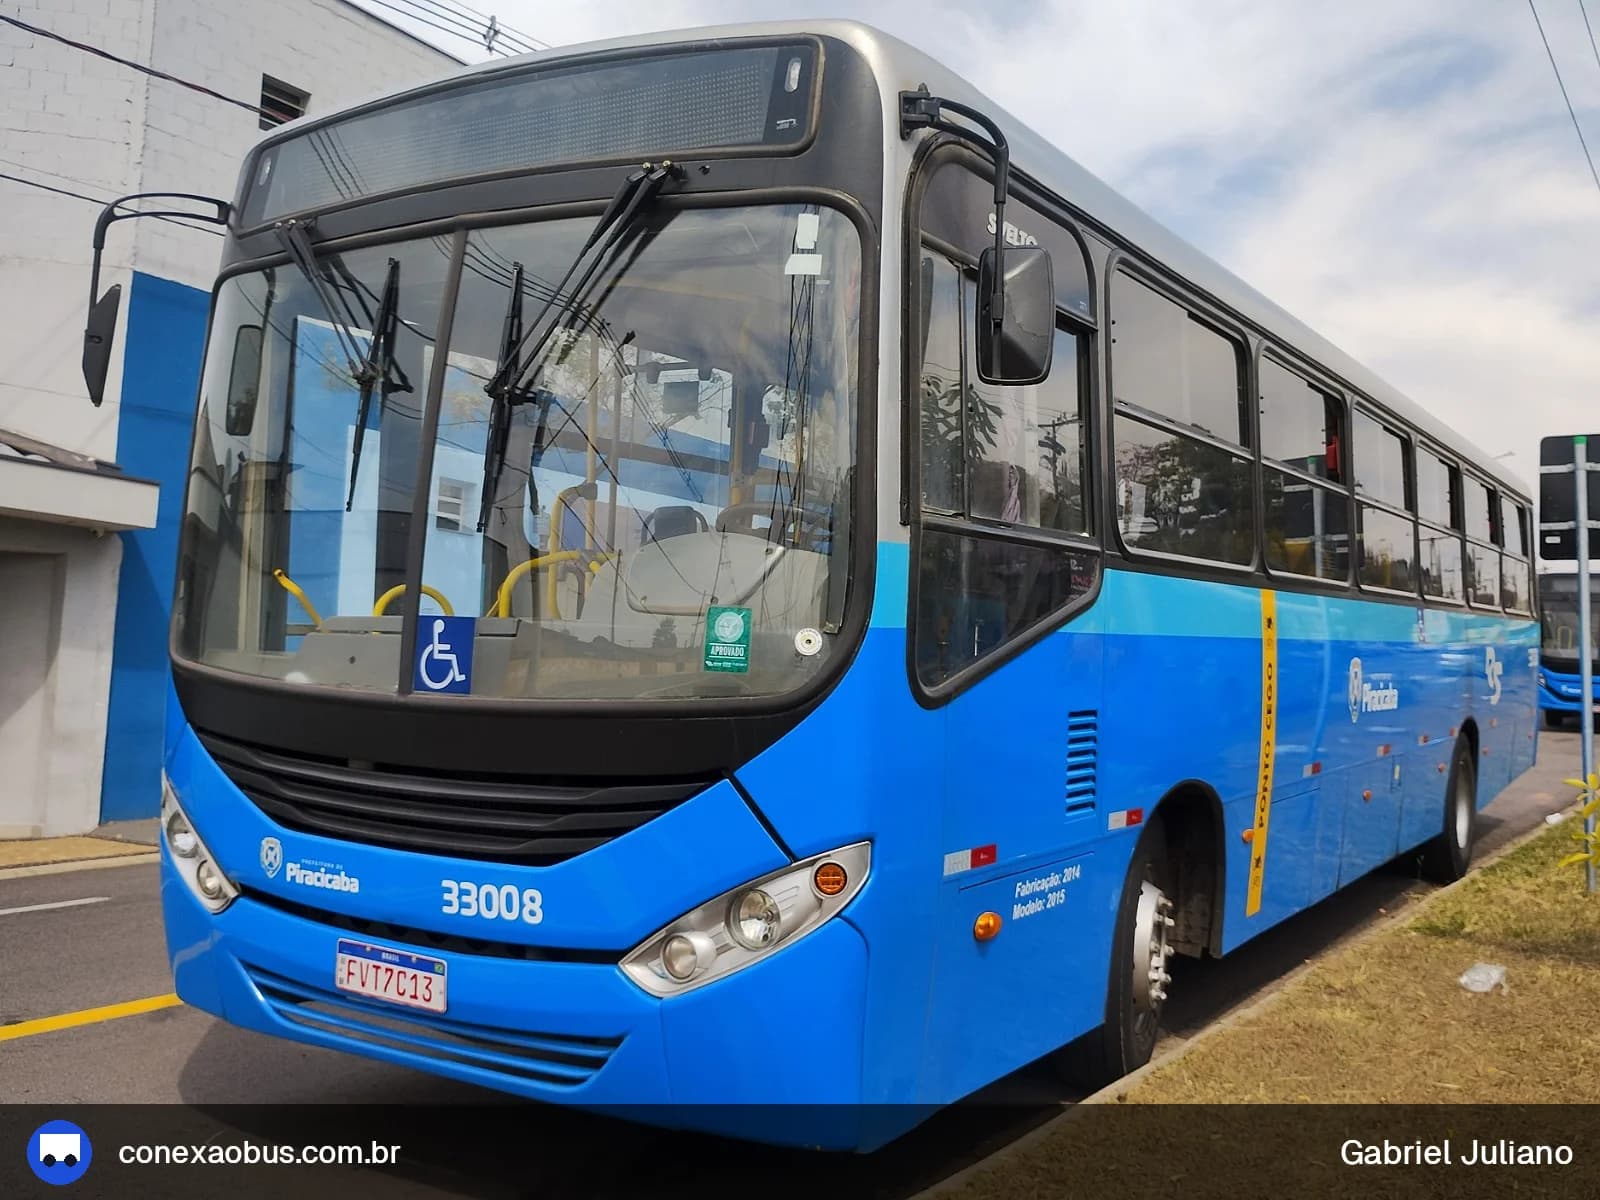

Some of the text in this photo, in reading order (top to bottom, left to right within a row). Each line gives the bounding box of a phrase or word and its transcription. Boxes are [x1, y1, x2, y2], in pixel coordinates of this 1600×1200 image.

[710, 645, 745, 656] APROVADO
[1257, 740, 1271, 829] PONTO
[286, 862, 359, 893] Piracicaba
[1015, 864, 1080, 898] Fabricação: 2014
[441, 879, 543, 925] 33008
[1012, 889, 1065, 920] Modelo: 2015
[346, 959, 433, 1002] FVT7C13
